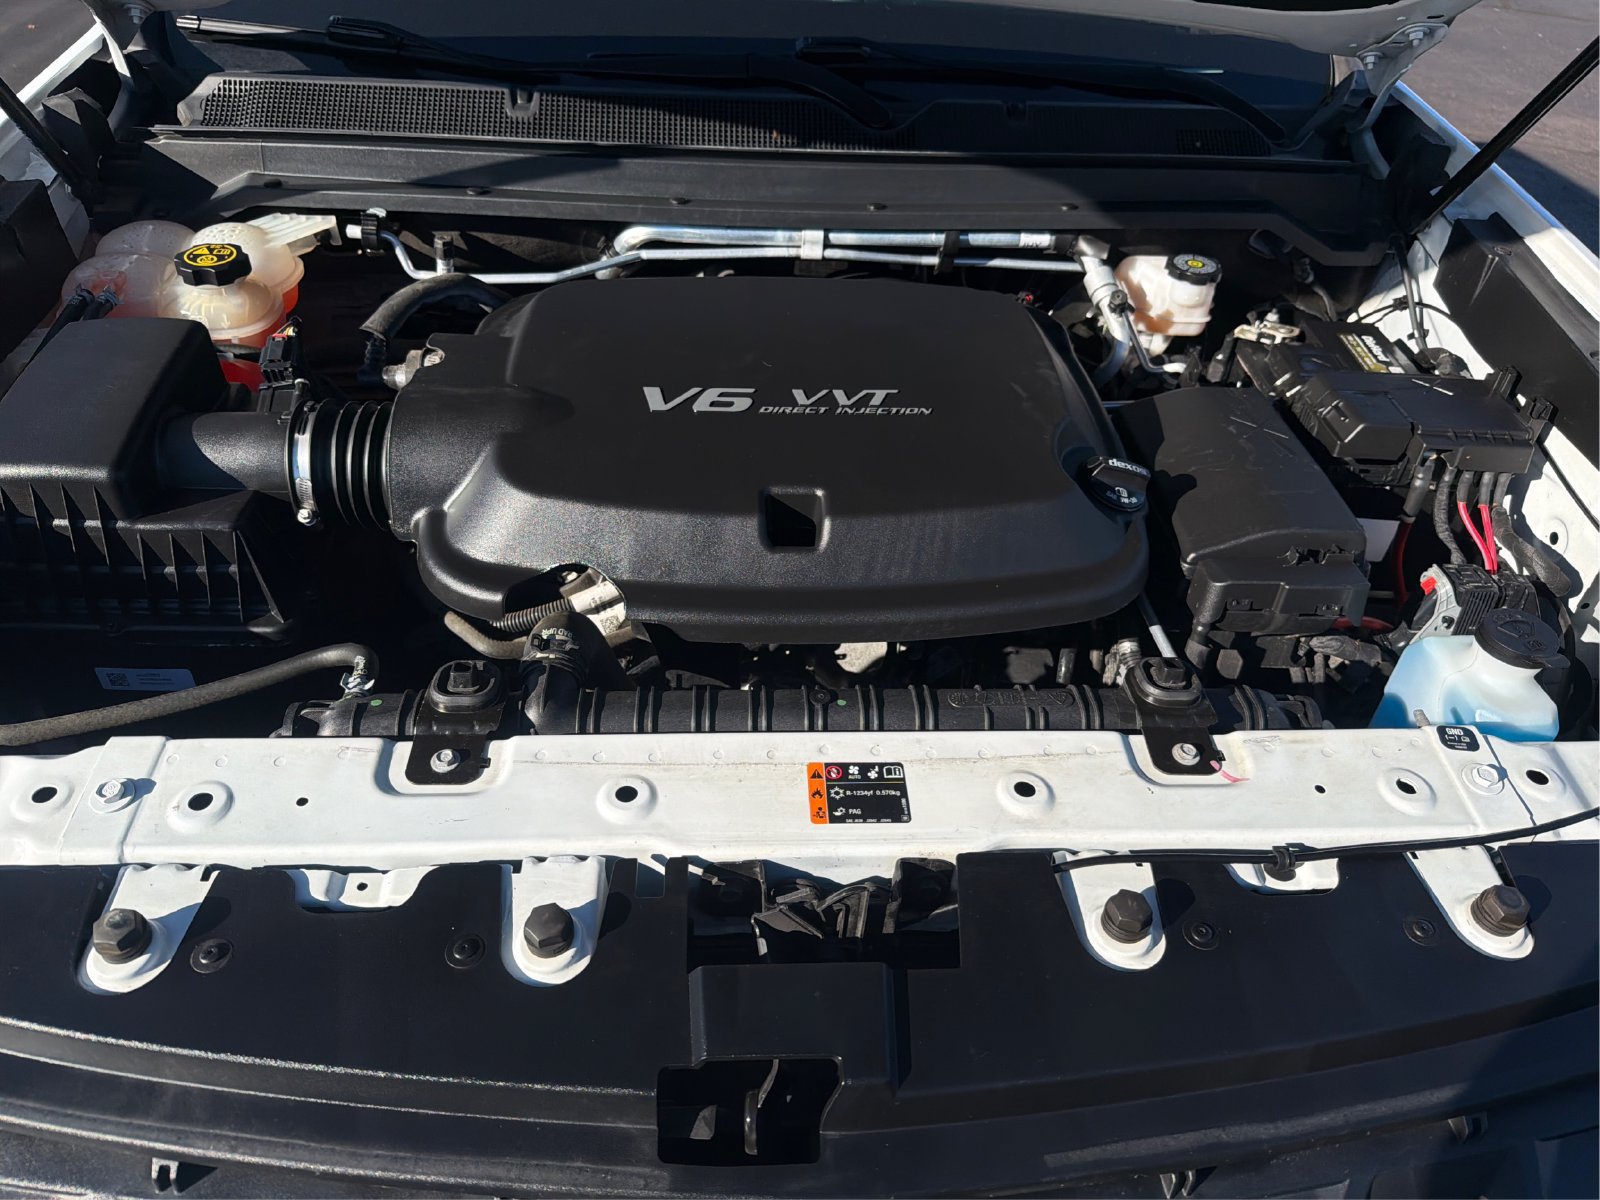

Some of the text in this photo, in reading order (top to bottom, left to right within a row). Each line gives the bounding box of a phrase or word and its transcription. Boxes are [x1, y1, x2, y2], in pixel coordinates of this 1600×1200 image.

[643, 386, 899, 413] V6 VVT
[758, 406, 934, 416] DIRECT INJECTION
